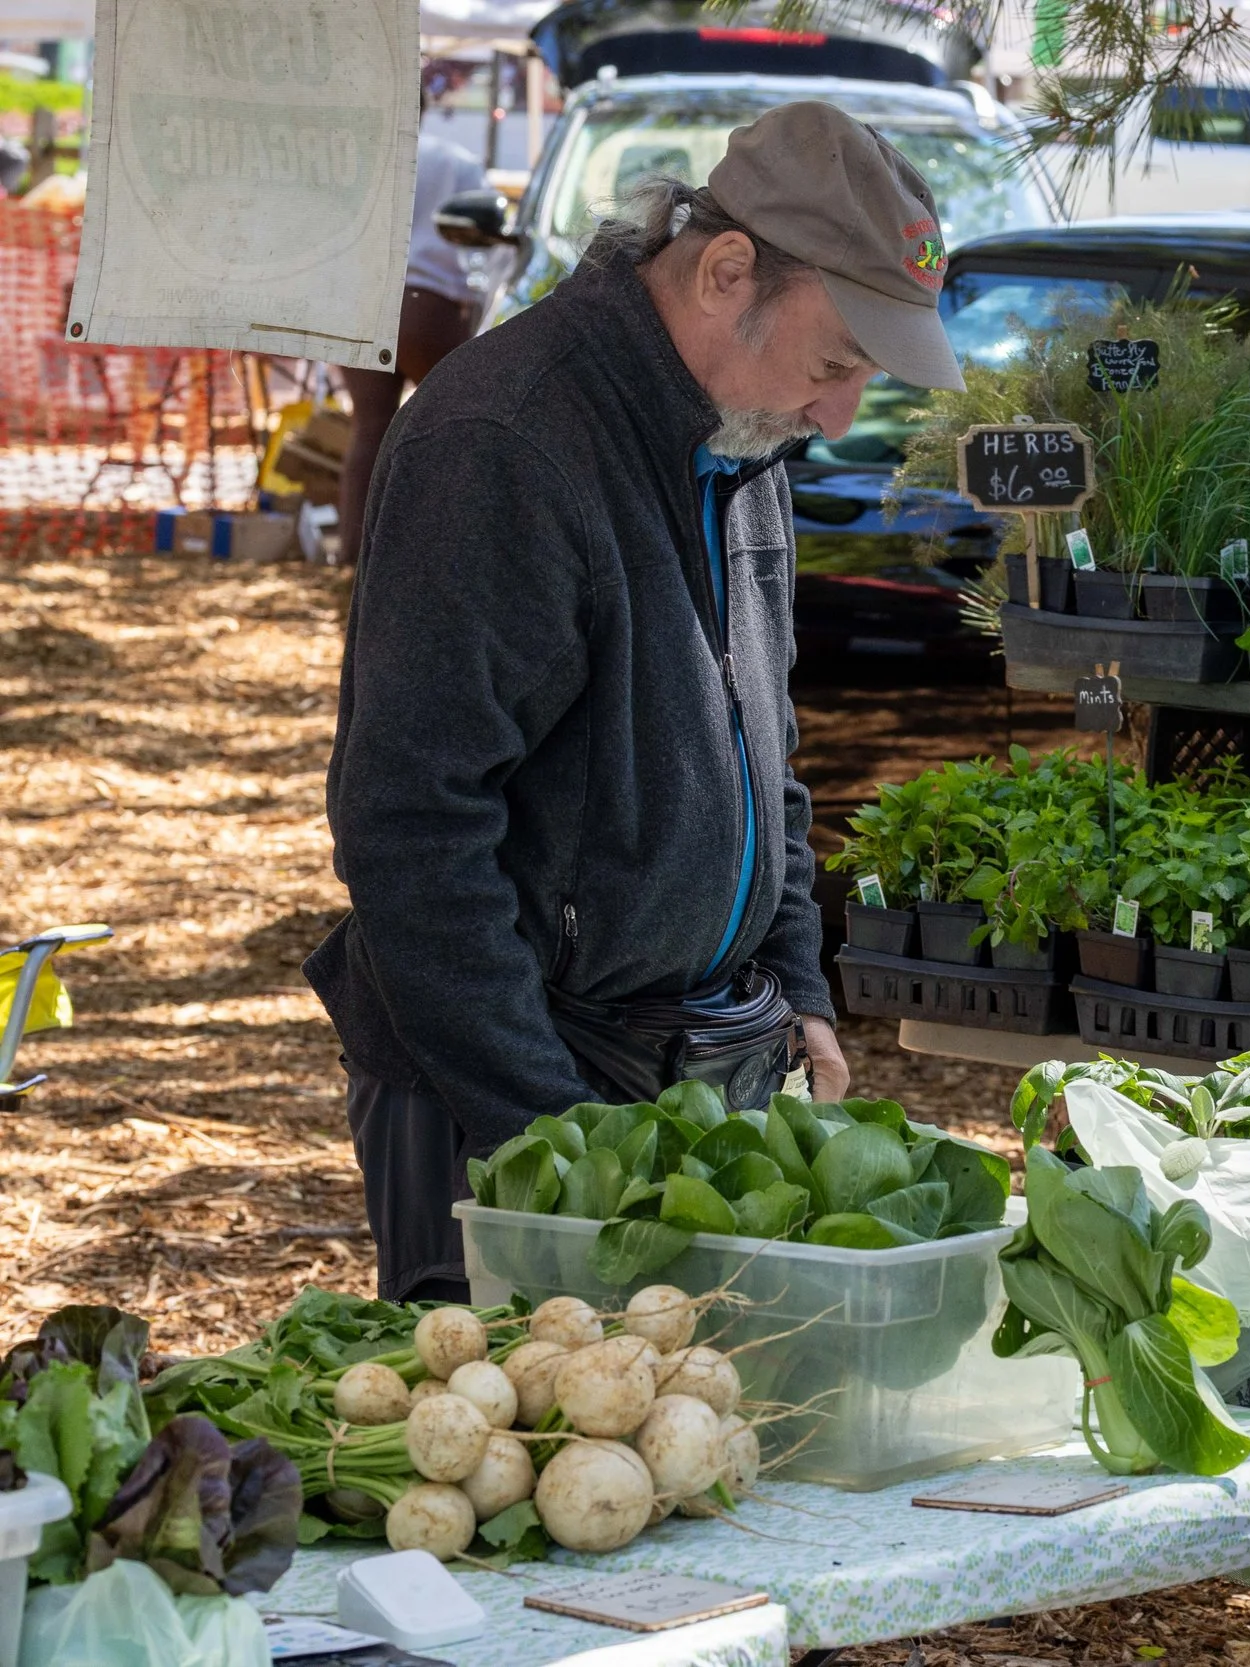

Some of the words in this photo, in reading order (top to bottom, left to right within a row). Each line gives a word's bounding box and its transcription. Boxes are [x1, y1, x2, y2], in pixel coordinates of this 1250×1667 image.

[984, 432, 1075, 456] HERBS
[989, 465, 1034, 502] $6
[1079, 685, 1115, 705] Mints
